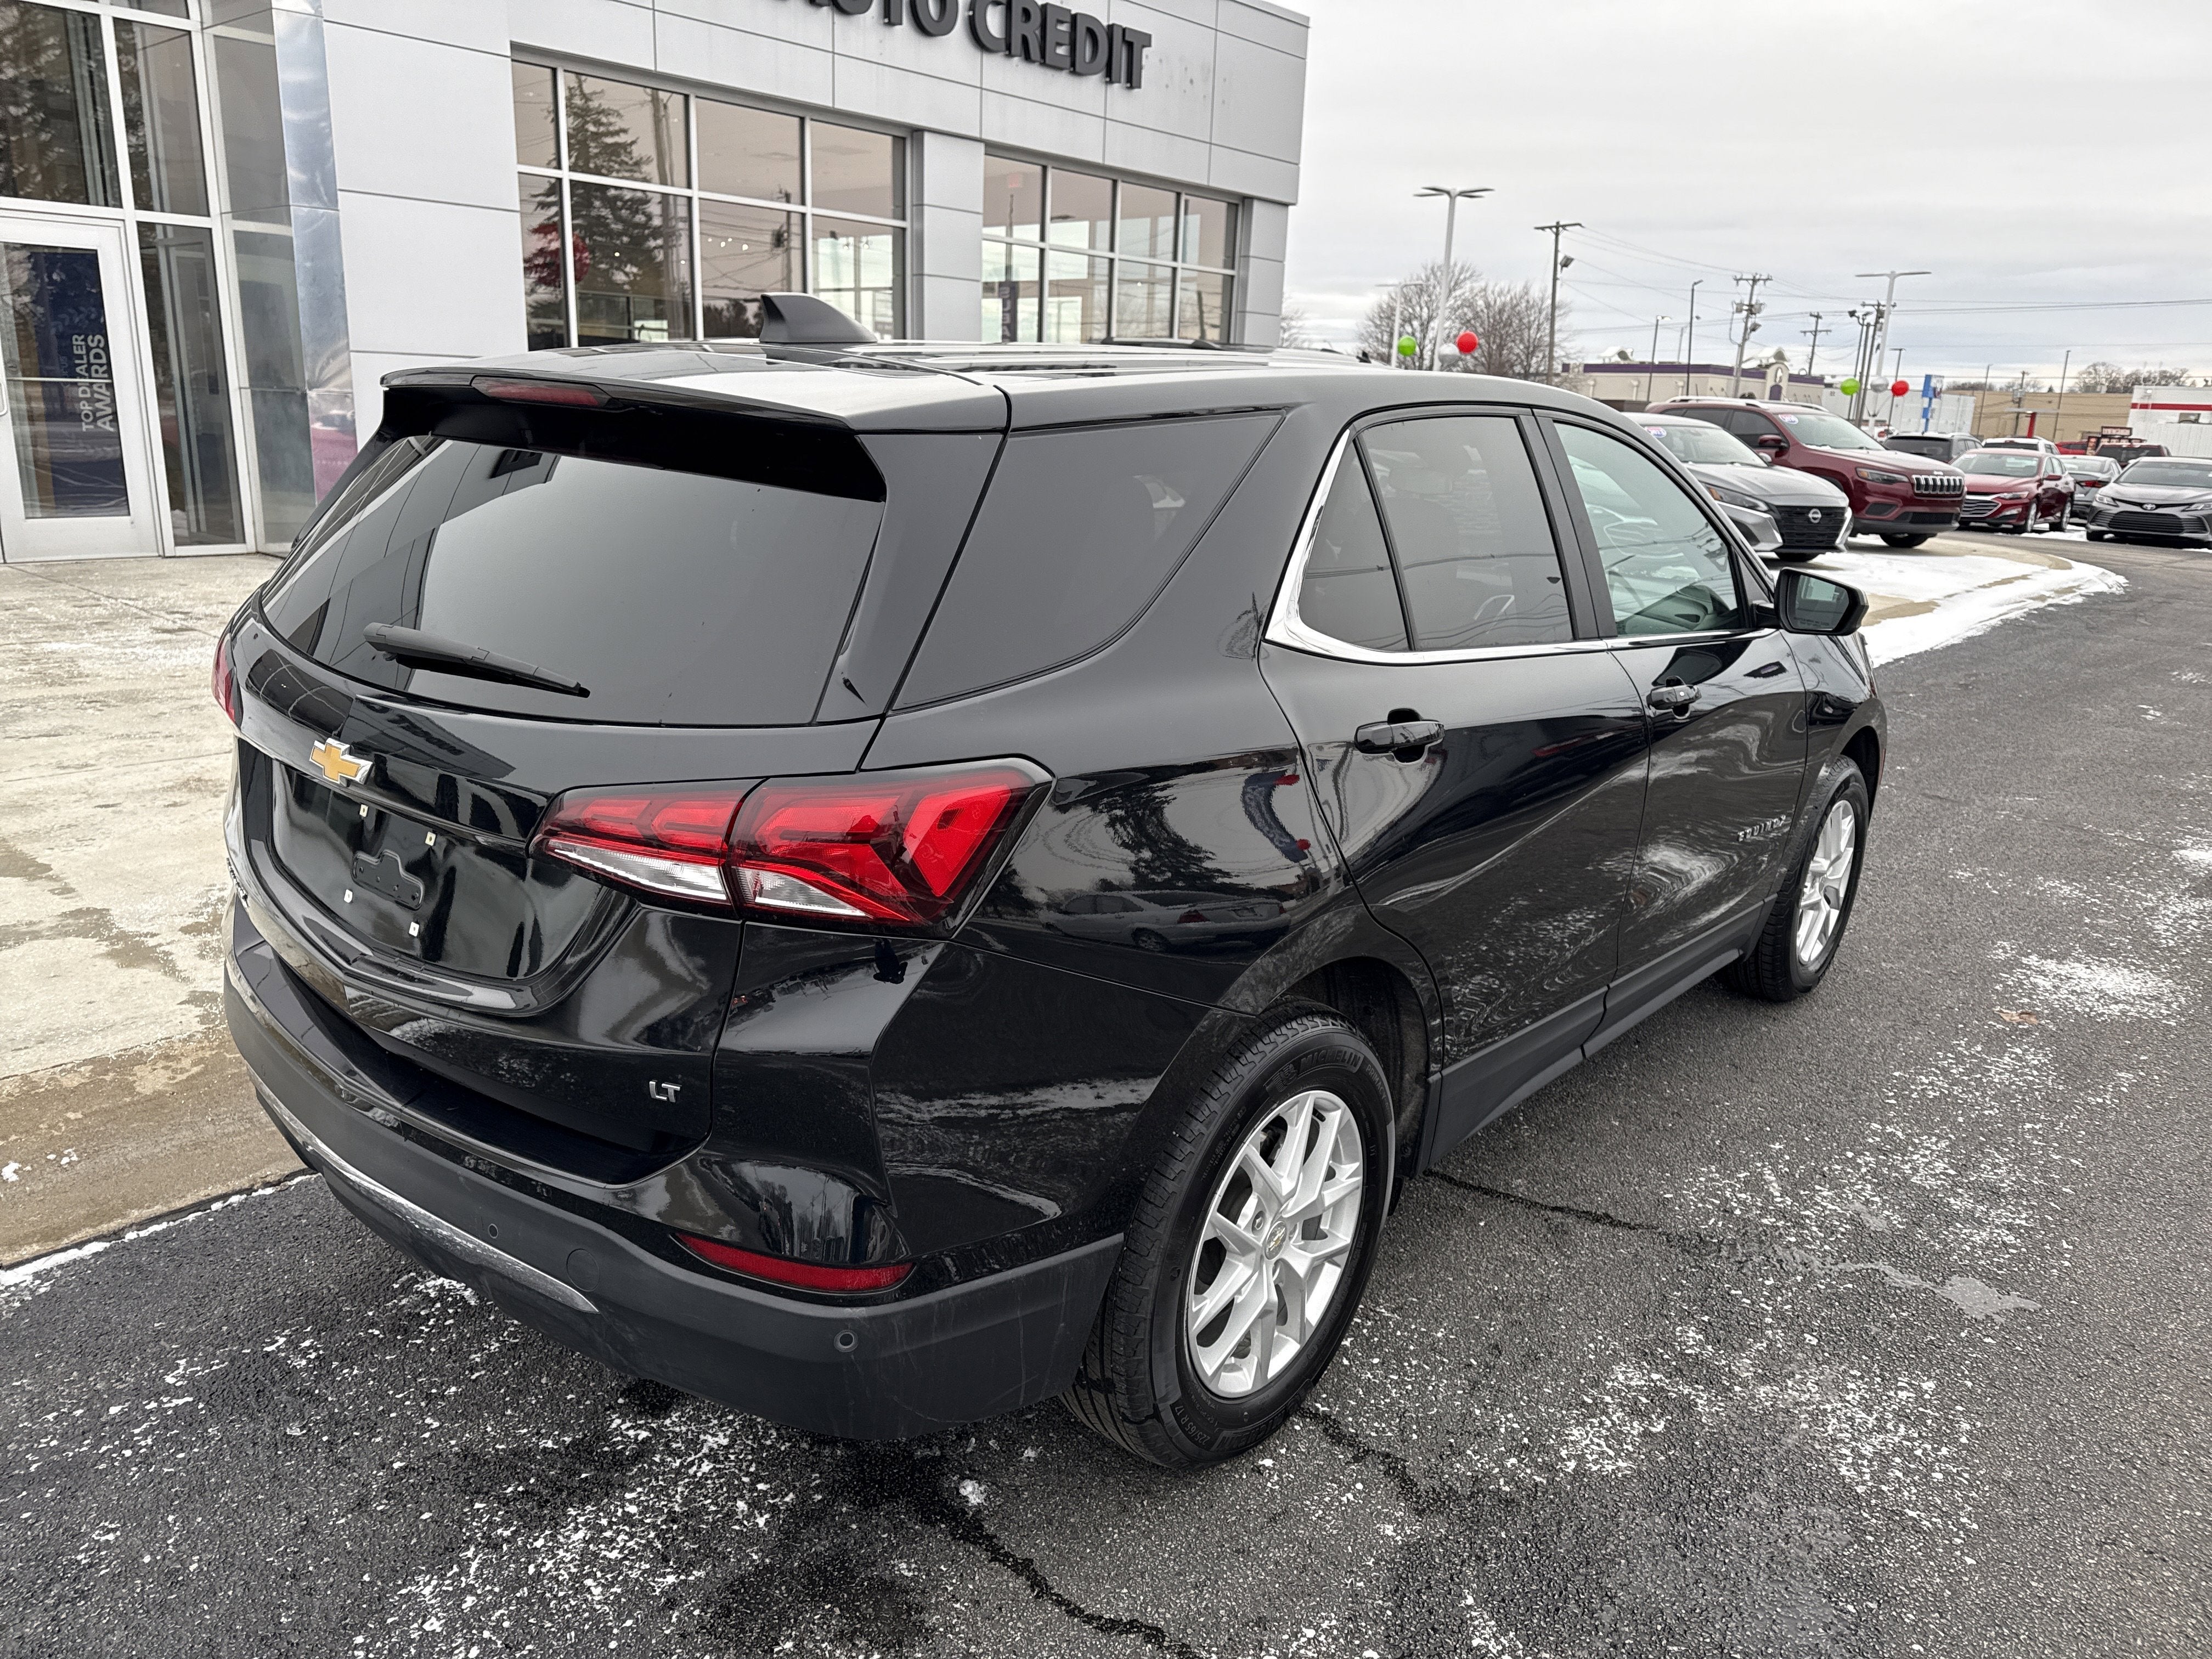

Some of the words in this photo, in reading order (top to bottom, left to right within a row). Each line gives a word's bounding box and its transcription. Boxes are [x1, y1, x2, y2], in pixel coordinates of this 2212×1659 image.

[969, 0, 1153, 89] CREDIT
[87, 334, 114, 432] AWARDS
[80, 400, 94, 432] TOP
[1737, 815, 1786, 842] EQUINOX
[1300, 1048, 1362, 1071] MICHELIN
[1366, 1064, 1387, 1100] PRIMACY
[649, 1080, 681, 1103] LT
[1175, 1406, 1184, 1415] 17
[1180, 1415, 1189, 1424] R
[1184, 1421, 1211, 1445] 225/65
